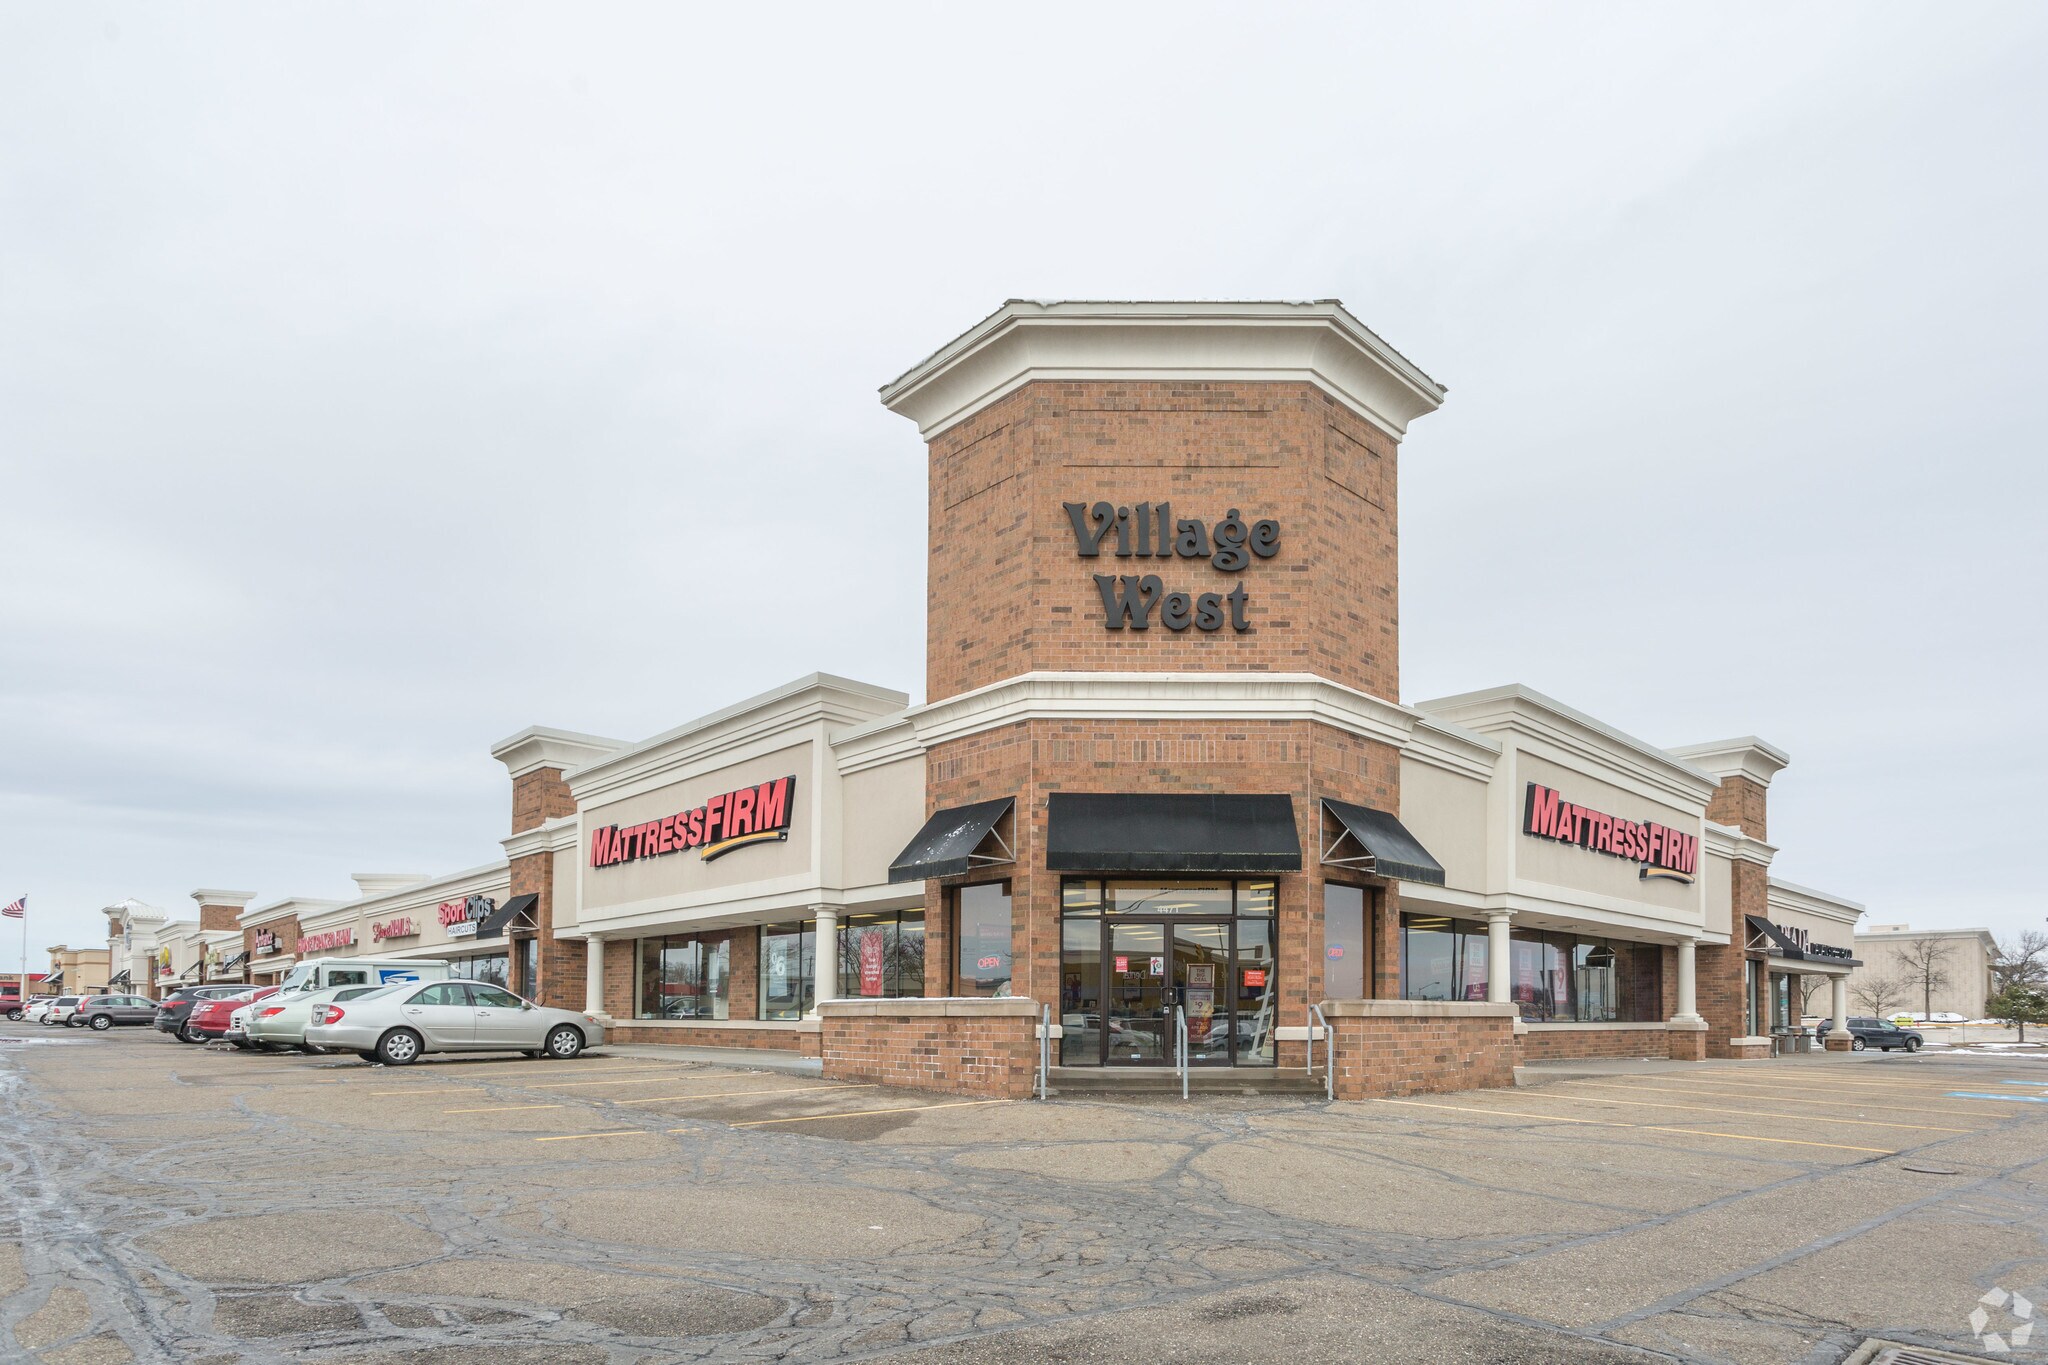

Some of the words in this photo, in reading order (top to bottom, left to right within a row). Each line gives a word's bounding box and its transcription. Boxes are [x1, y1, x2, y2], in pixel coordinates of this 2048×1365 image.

[1062, 501, 1281, 572] Village
[1093, 574, 1250, 631] West
[447, 923, 476, 935] HAIRCUTS
[977, 957, 999, 968] OPEN
